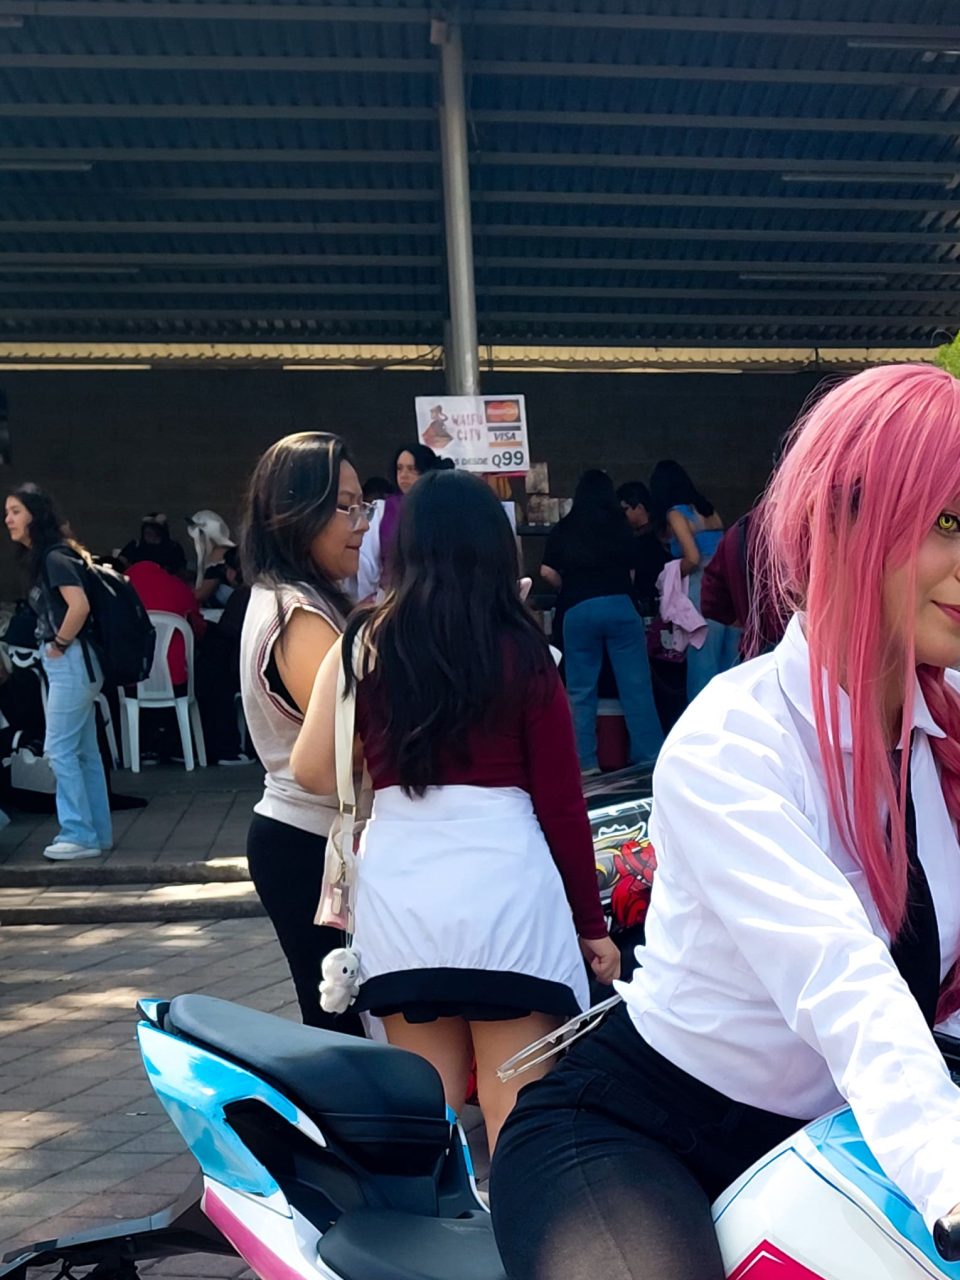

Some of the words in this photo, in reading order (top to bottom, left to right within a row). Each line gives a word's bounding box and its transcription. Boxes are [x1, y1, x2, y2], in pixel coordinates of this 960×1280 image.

[451, 413, 483, 426] WAIFU
[456, 428, 481, 441] CITY
[493, 432, 516, 441] VISA
[491, 450, 524, 468] Q99
